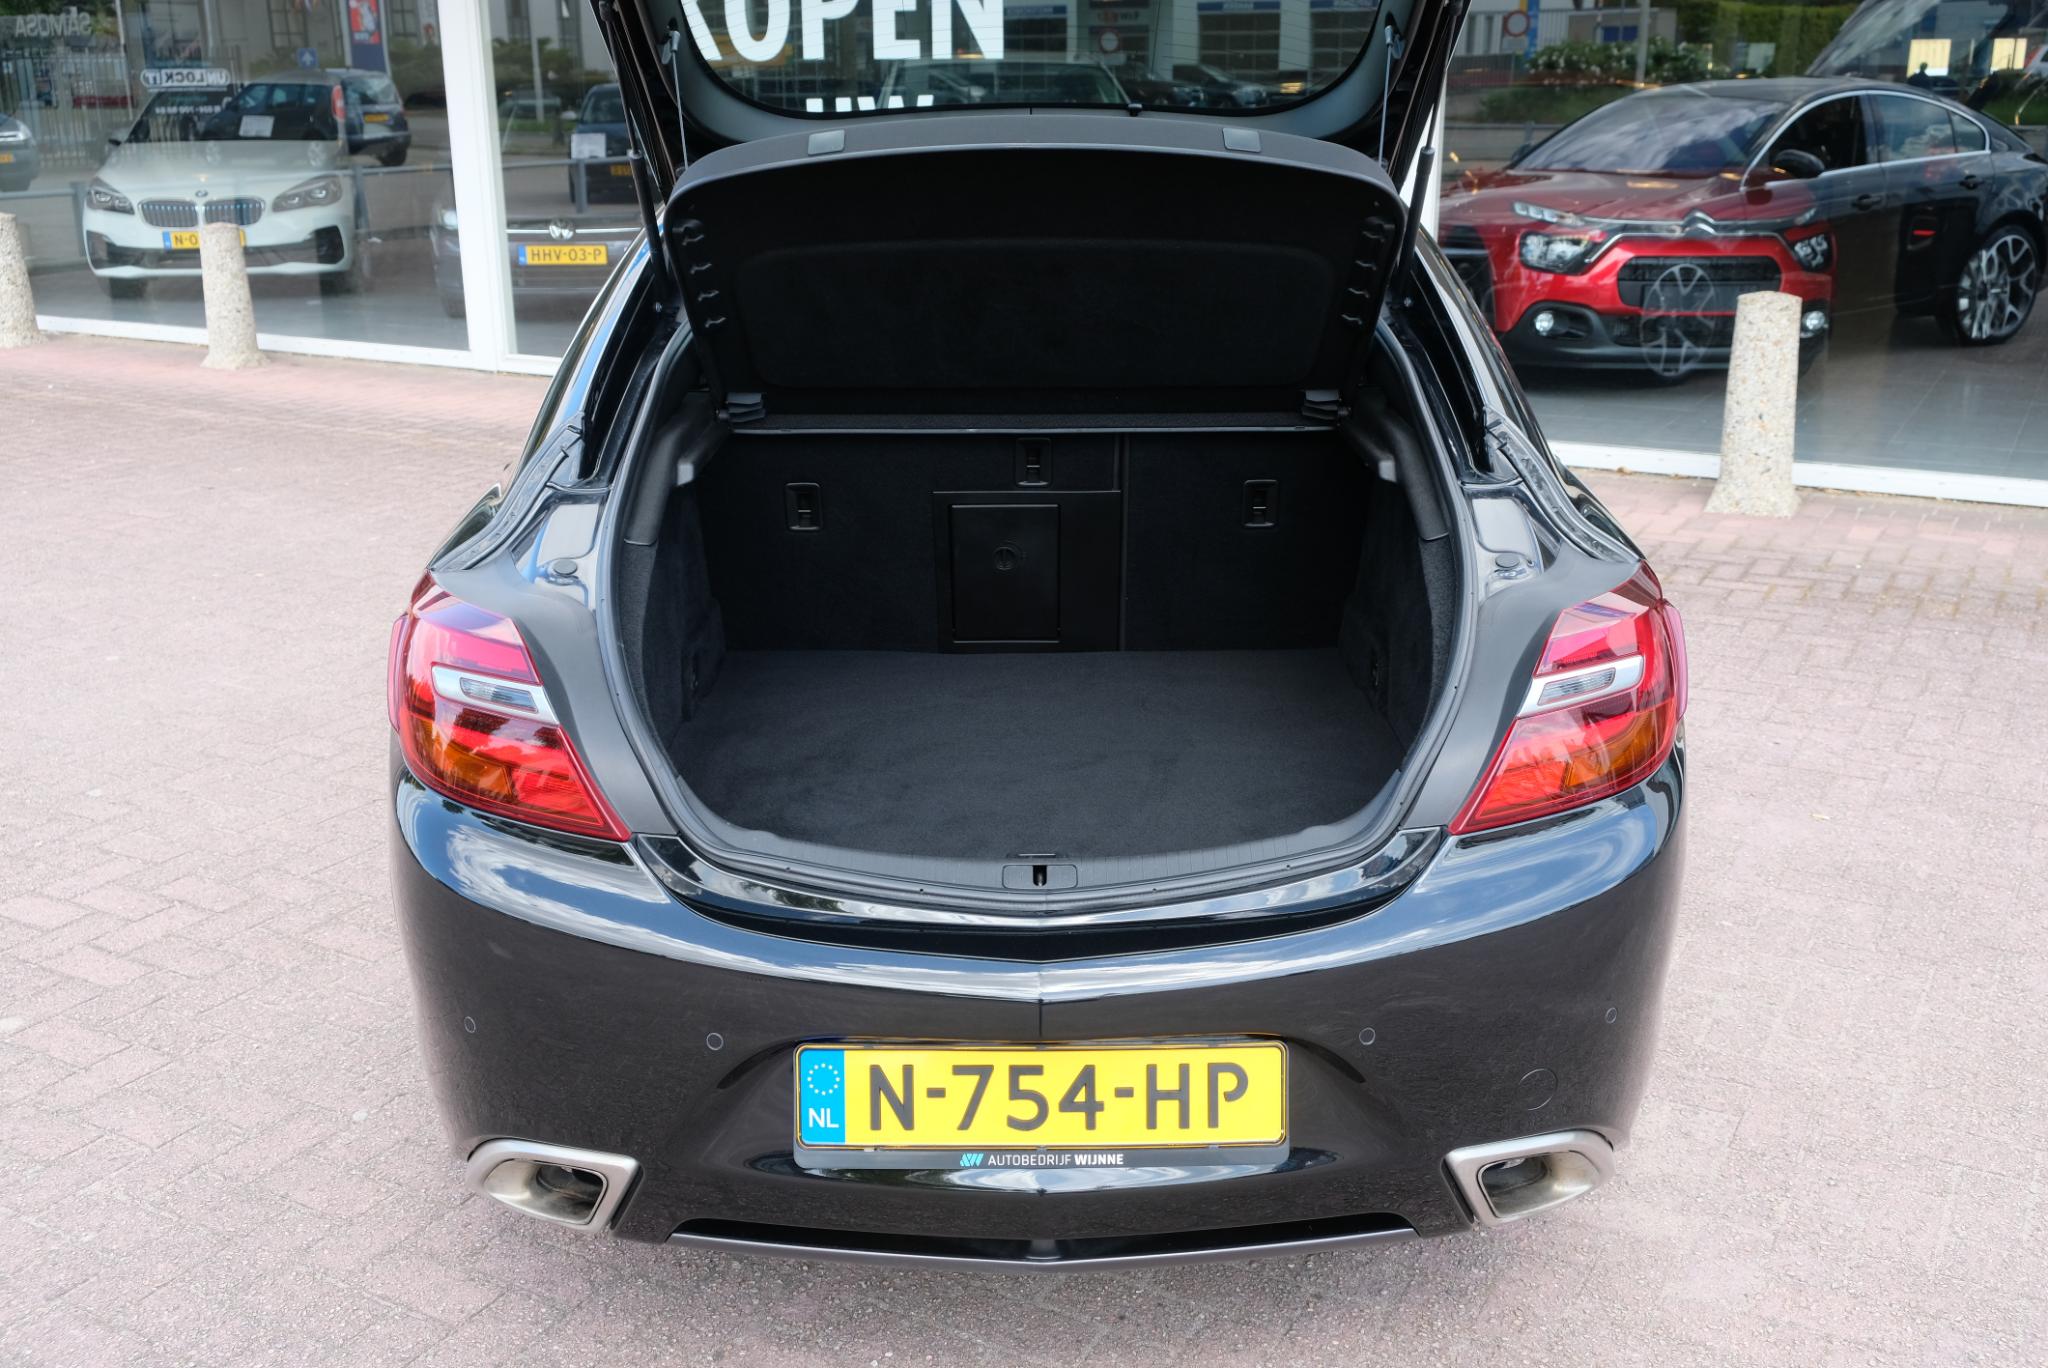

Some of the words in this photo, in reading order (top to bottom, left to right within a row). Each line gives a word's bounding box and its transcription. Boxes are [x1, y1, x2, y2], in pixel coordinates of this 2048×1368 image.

[530, 247, 602, 262] HHV-03-P
[869, 1062, 1249, 1131] N-754-HP
[808, 1107, 840, 1128] NL
[987, 1153, 1071, 1166] AUTOBEDRIJF
[1074, 1153, 1124, 1165] WIJNNE
